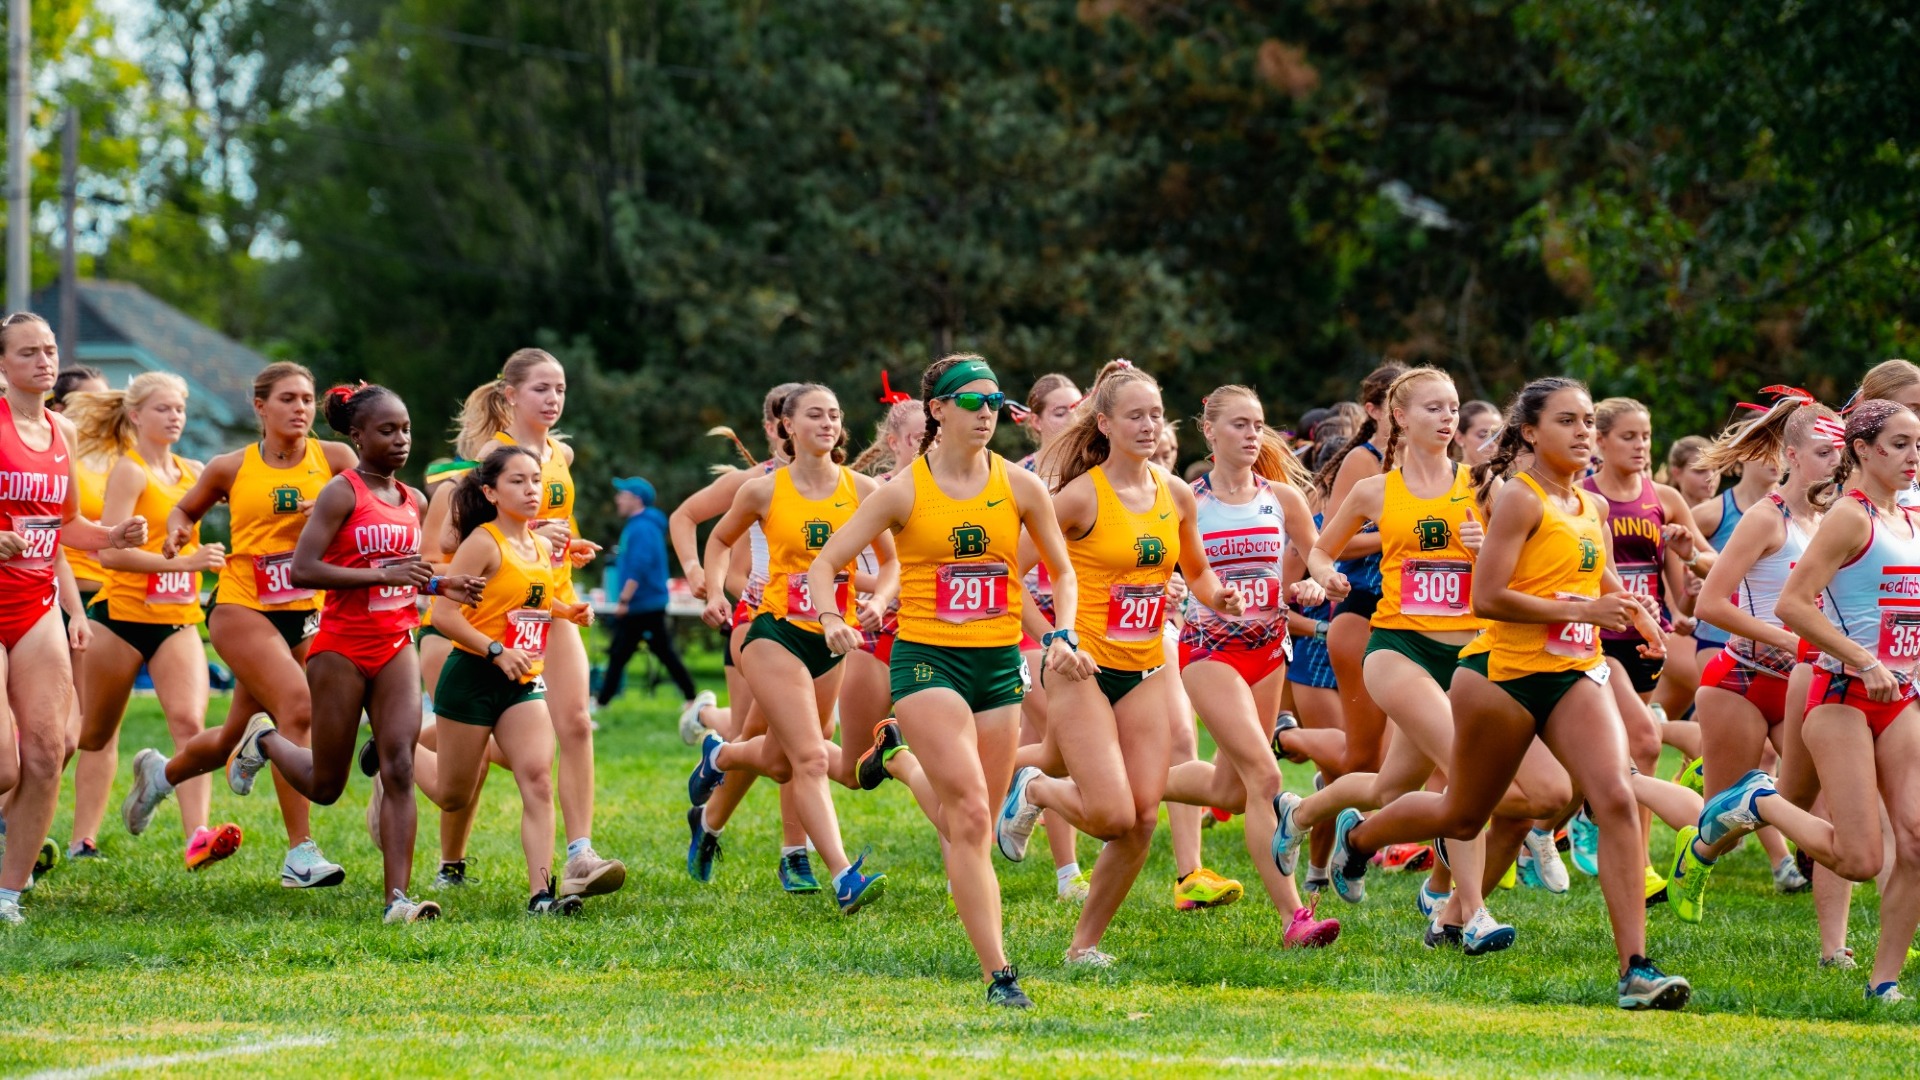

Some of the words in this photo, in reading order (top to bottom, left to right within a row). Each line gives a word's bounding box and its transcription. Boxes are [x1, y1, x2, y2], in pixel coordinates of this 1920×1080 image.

[272, 486, 302, 514] B
[548, 481, 568, 508] B
[804, 520, 832, 550] B
[951, 523, 988, 559] B
[1416, 516, 1450, 551] B
[1136, 535, 1165, 567] B
[1579, 537, 1598, 572] B
[156, 571, 190, 593] 304
[266, 563, 296, 592] 30
[1413, 572, 1460, 603] 309
[1619, 574, 1648, 597] 76
[949, 577, 995, 610] 291
[1119, 597, 1161, 628] 297
[513, 621, 543, 649] 294
